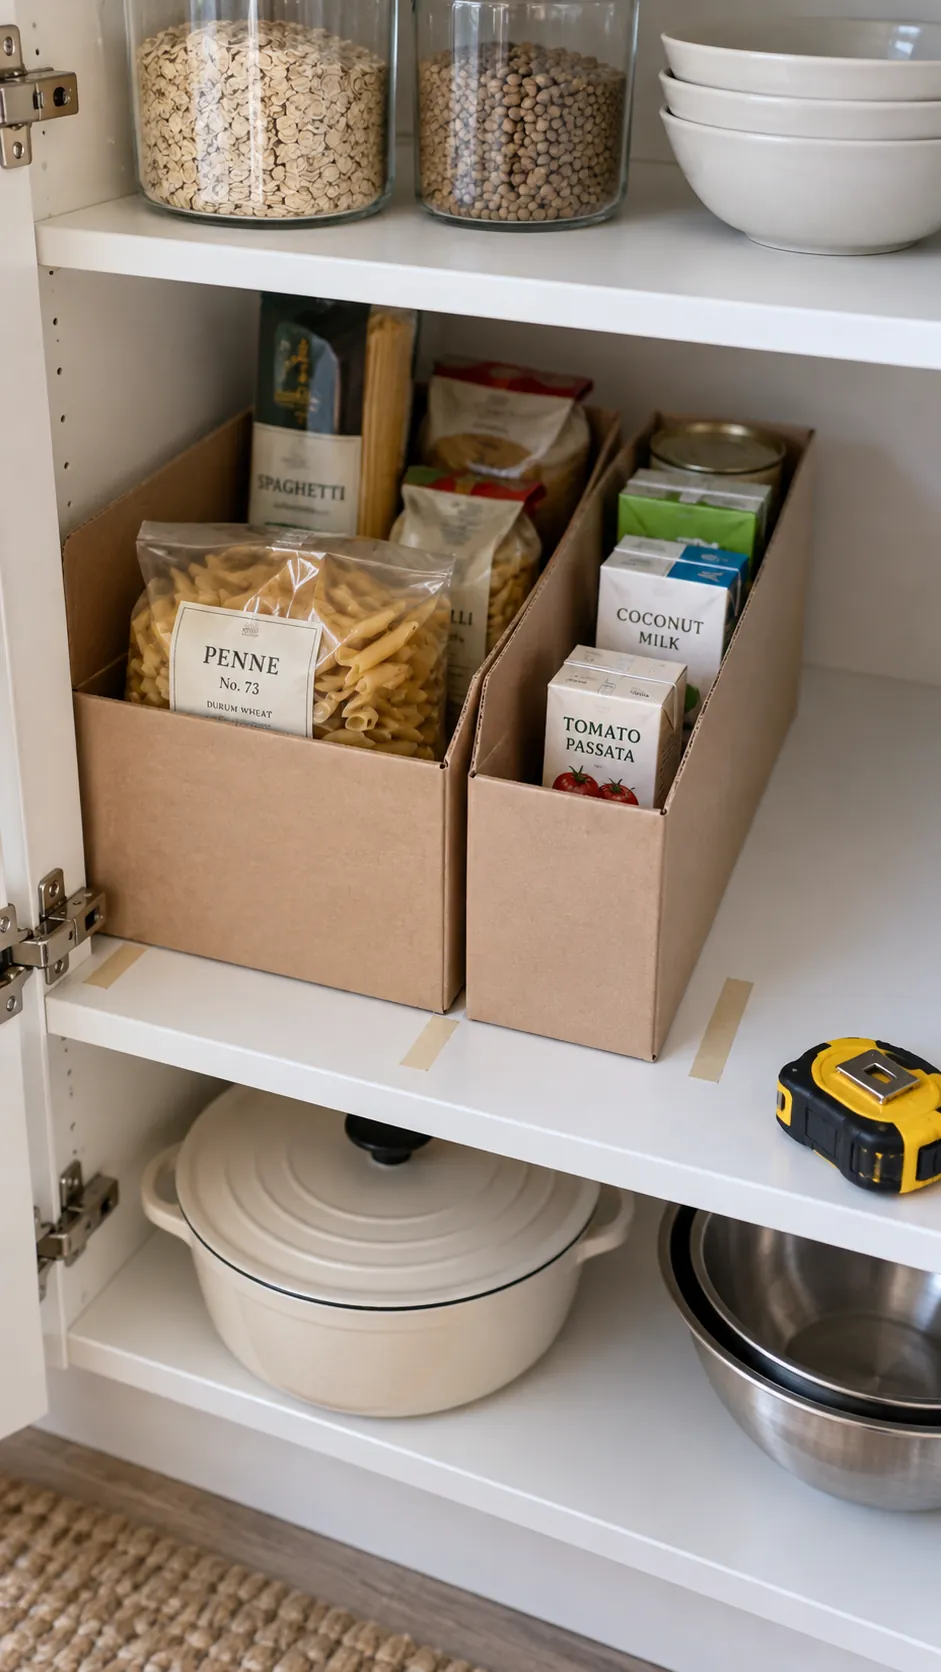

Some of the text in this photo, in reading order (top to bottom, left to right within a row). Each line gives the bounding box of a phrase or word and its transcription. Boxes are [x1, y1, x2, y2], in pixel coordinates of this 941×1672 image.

[257, 474, 346, 501] SPAGHETTI
[450, 609, 473, 626] LLI
[616, 607, 705, 635] COCONUT
[638, 631, 680, 651] MILK
[203, 645, 280, 675] PENNE
[219, 676, 260, 696] No. 73
[206, 700, 273, 719] DURUM WHEAT
[563, 716, 642, 744] TOMATO
[566, 737, 635, 763] PASSATA
